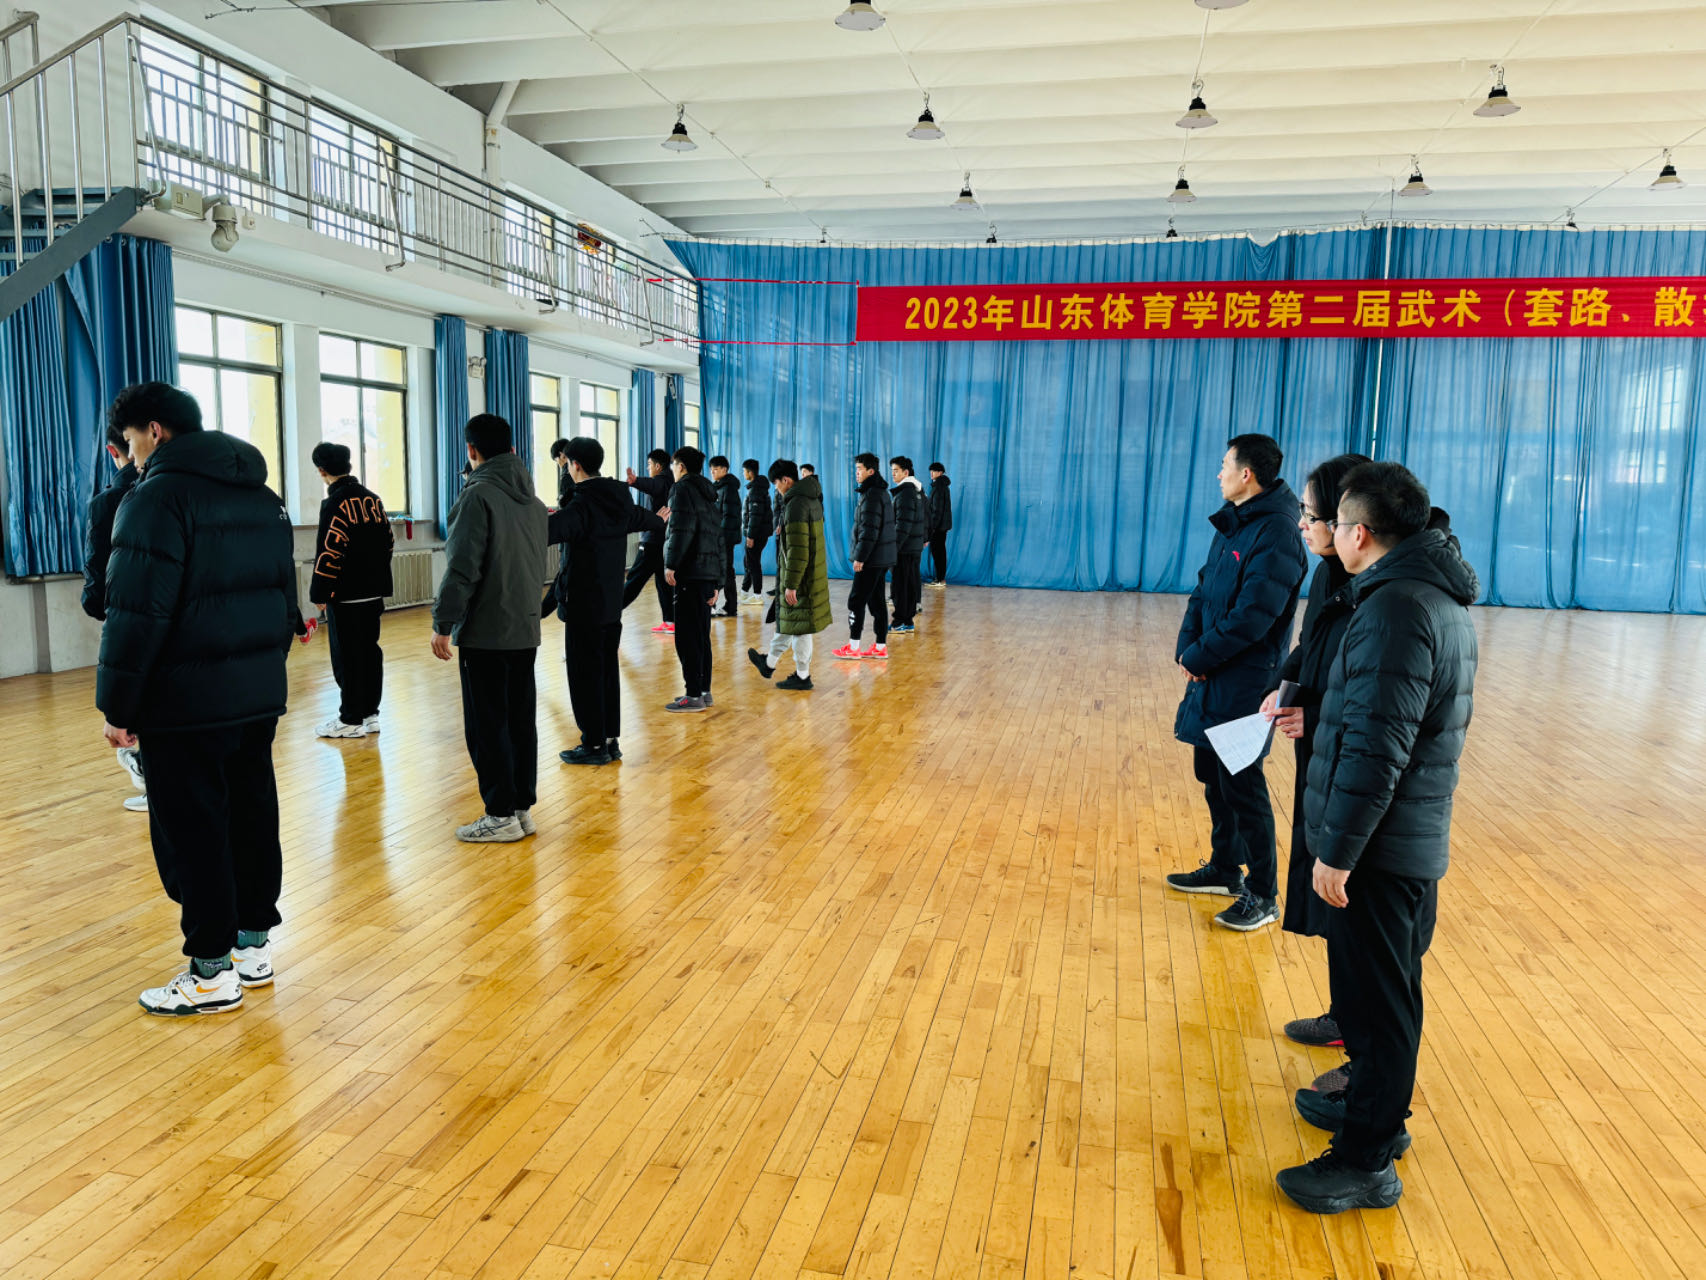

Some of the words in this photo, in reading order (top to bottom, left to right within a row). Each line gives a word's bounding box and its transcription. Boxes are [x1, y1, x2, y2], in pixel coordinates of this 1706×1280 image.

[905, 286, 1706, 331] 2023年山东体育学院第二届武术（套路、散
